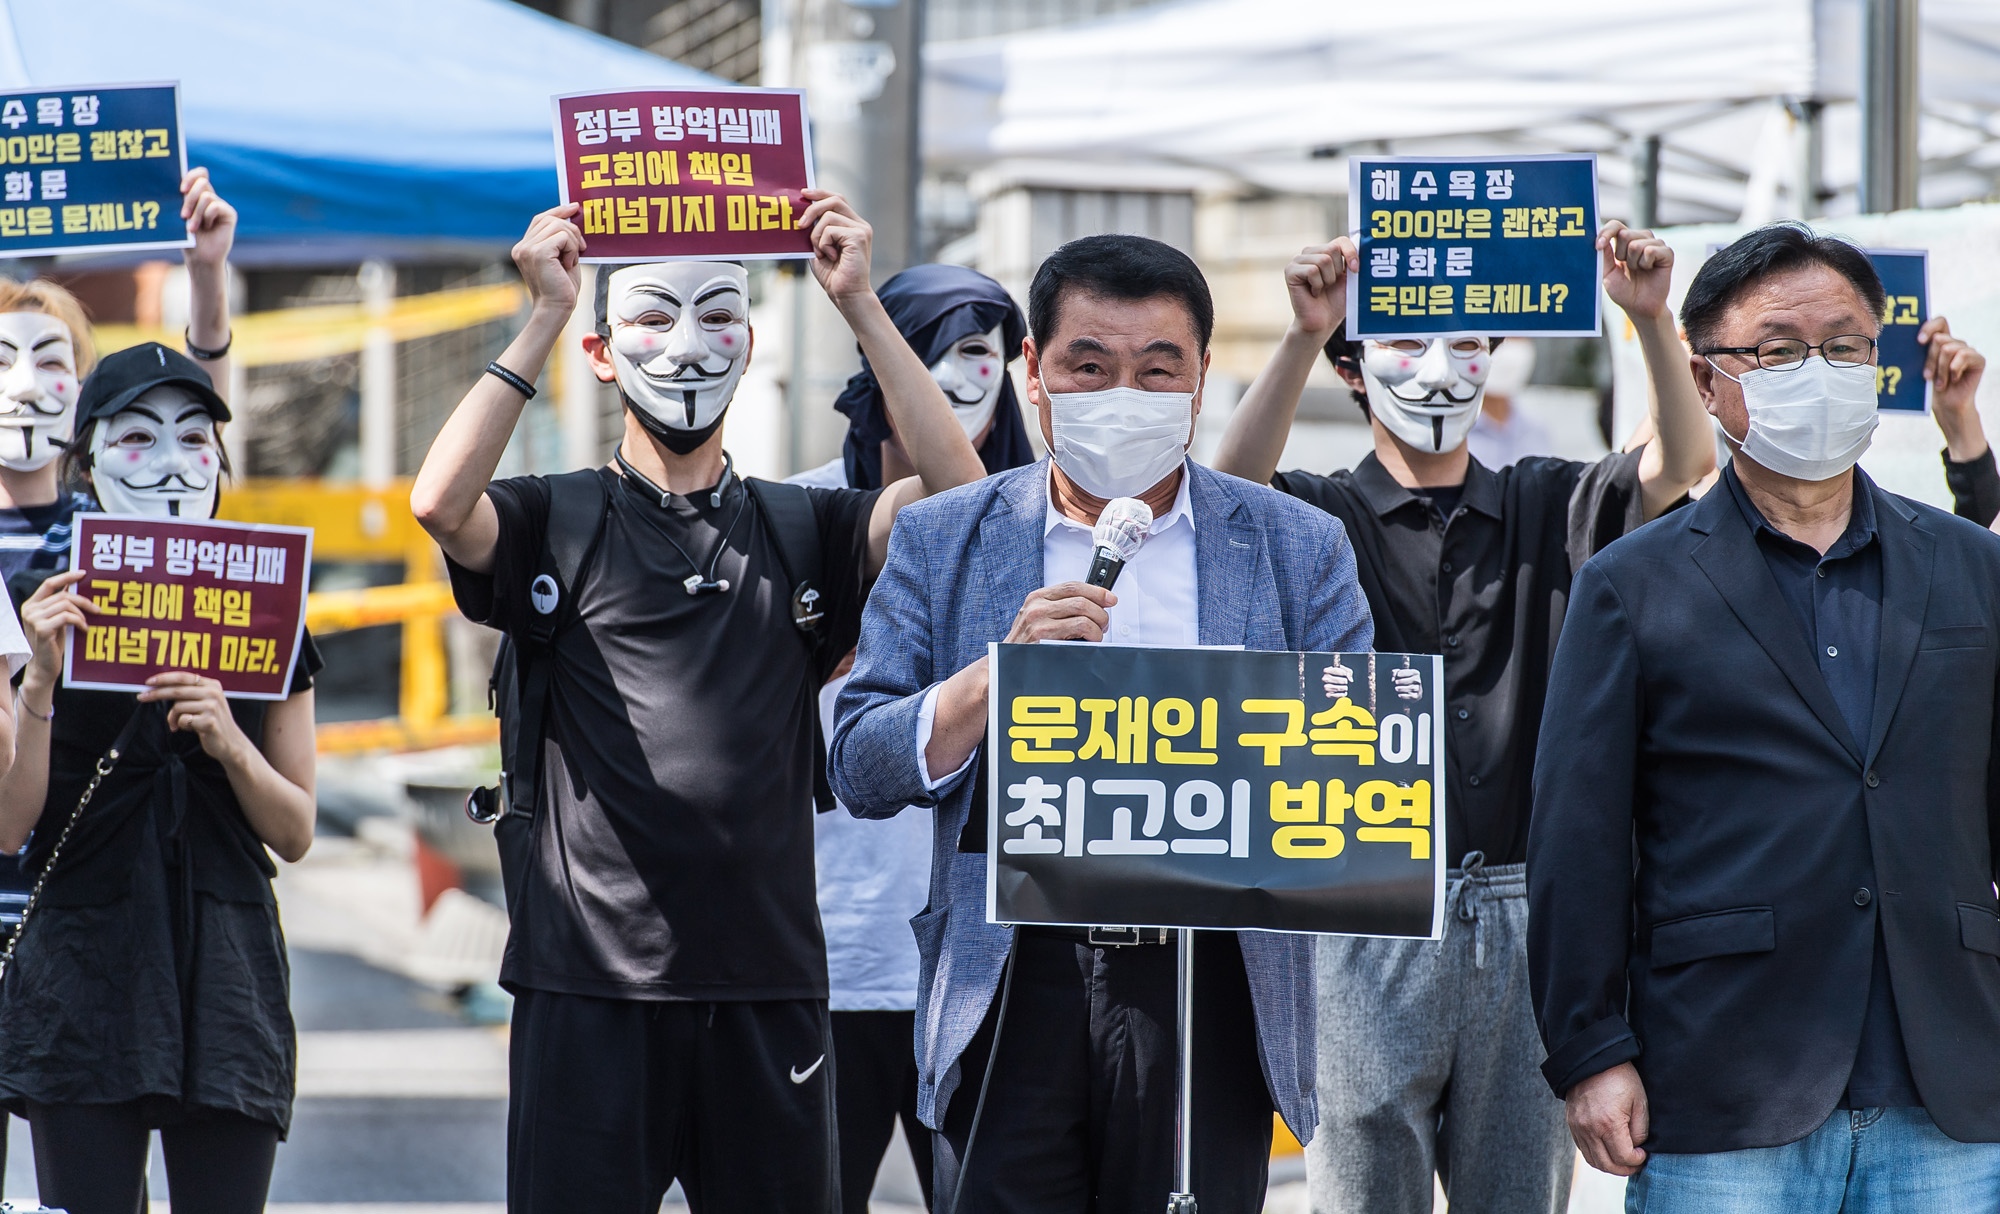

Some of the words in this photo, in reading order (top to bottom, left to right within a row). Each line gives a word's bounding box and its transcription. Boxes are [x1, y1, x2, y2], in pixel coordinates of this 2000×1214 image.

[90, 128, 170, 161] 괜찮고
[573, 107, 642, 146] 정부
[651, 106, 782, 145] 방역실패
[579, 150, 680, 190] 교회에
[687, 151, 755, 187] 책임
[62, 201, 160, 234] 문제냐?
[582, 194, 716, 235] 떠넘기지
[726, 194, 802, 231] 마라.
[1371, 209, 1491, 239] 300만은
[1501, 207, 1586, 238] 괜찮고
[1370, 285, 1453, 316] 국민은
[1465, 283, 1569, 313] 문제냐?
[92, 534, 154, 573] 정부
[166, 537, 286, 584] 방역실패
[90, 579, 184, 621] 교회에
[193, 586, 252, 628] 책임
[85, 625, 212, 670] 떠넘기지
[219, 635, 279, 674] 마라.
[1007, 695, 1219, 765] 문재인
[1237, 697, 1431, 766] 구속이
[1003, 775, 1251, 858] 최고의
[1269, 778, 1431, 860] 방역
